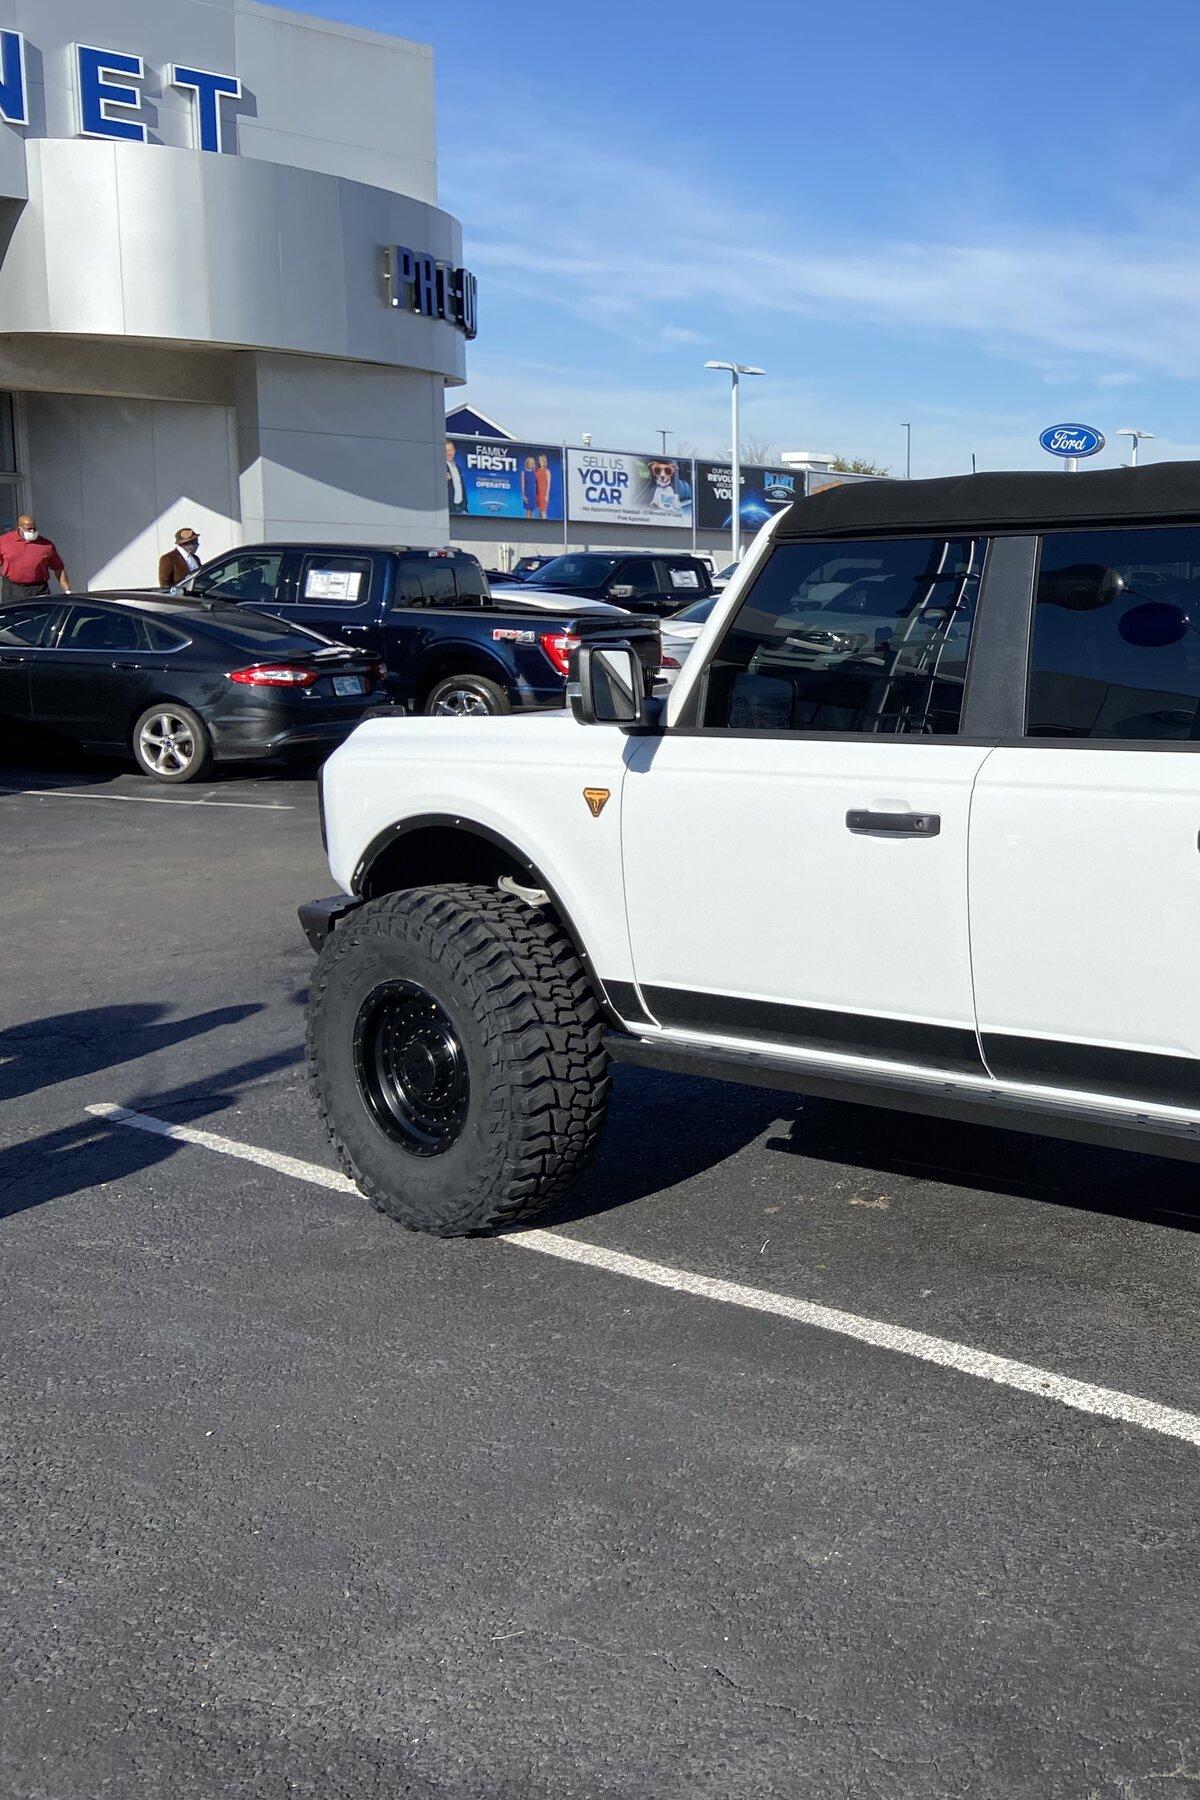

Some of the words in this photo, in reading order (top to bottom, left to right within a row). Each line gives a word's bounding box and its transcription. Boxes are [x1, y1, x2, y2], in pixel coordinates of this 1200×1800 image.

[1050, 429, 1087, 451] Ford
[475, 445, 508, 456] FAMILY
[466, 454, 517, 472] FIRST!
[582, 456, 608, 468] SELL
[609, 459, 624, 471] US
[475, 481, 511, 490] OPERATED
[578, 468, 629, 488] YOUR
[707, 474, 746, 484] REVOLS
[585, 486, 622, 505] CAR
[492, 629, 535, 642] FX4
